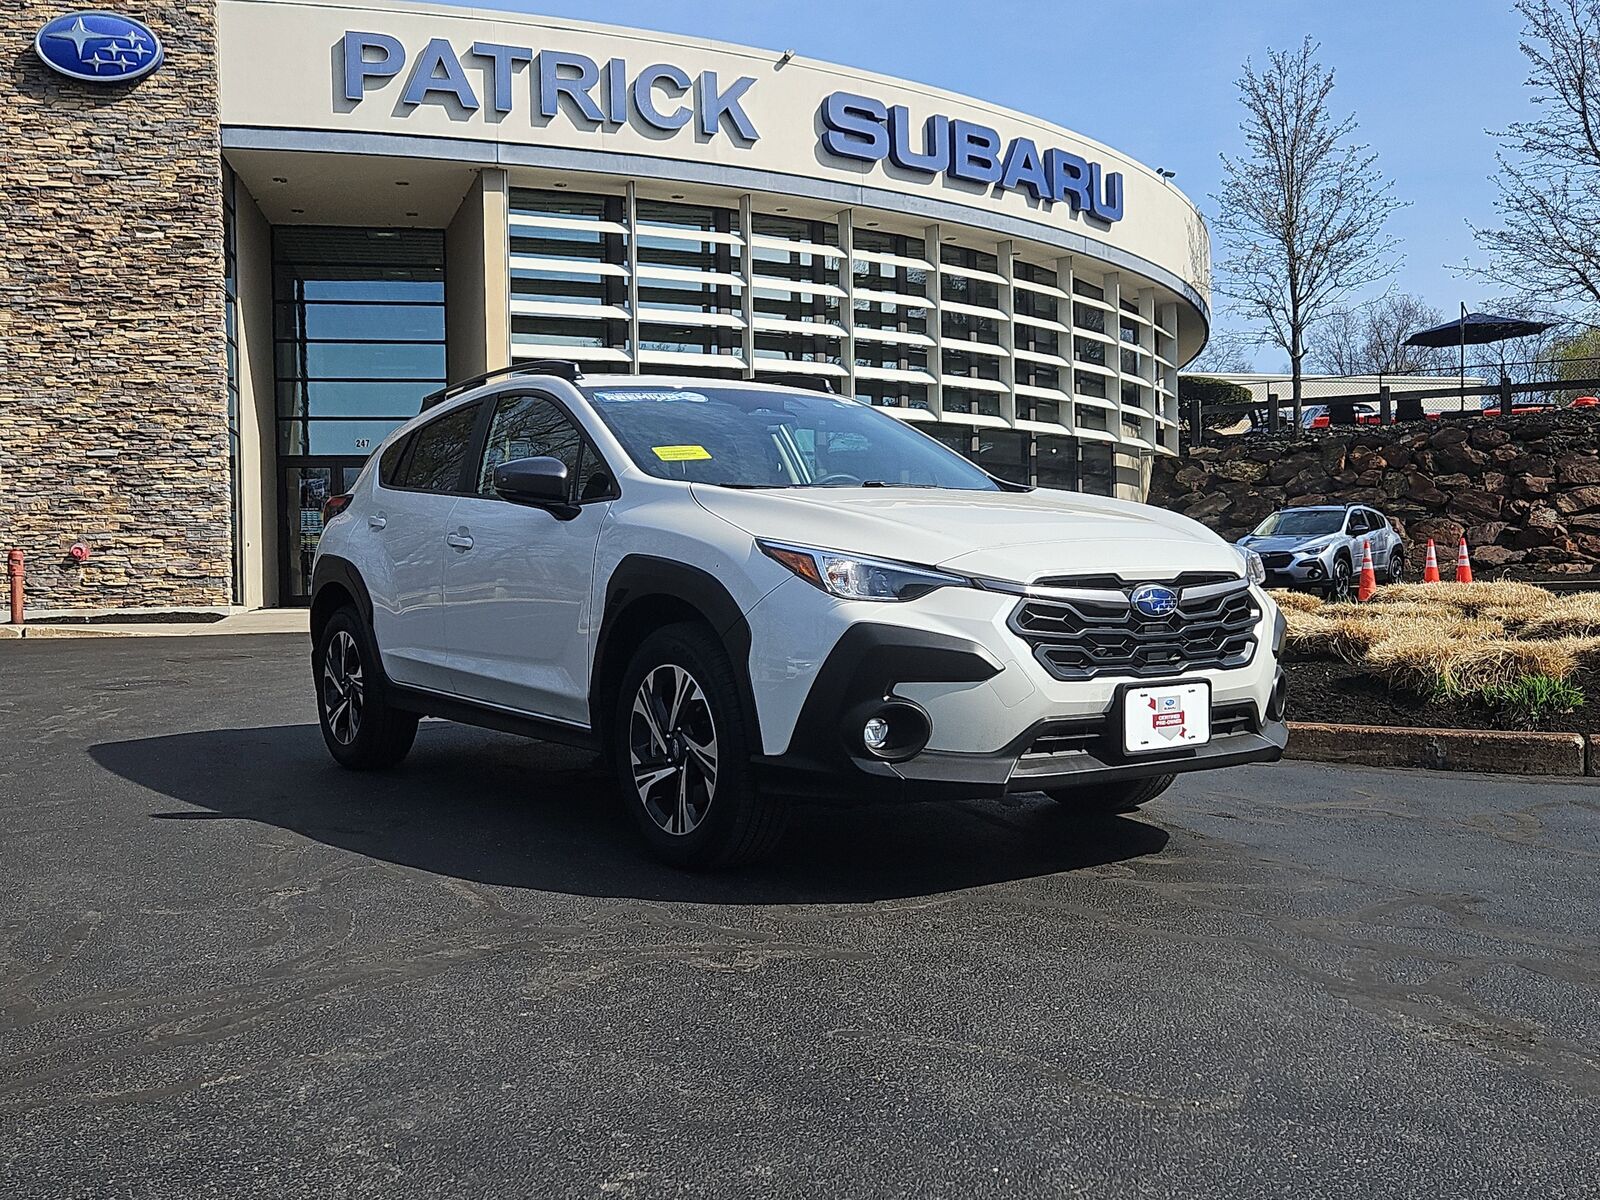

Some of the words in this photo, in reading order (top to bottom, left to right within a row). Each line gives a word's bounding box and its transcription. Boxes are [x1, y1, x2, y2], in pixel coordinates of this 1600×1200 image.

[344, 30, 760, 141] PATRICK
[822, 91, 1124, 222] SUBARU
[355, 439, 370, 448] 247
